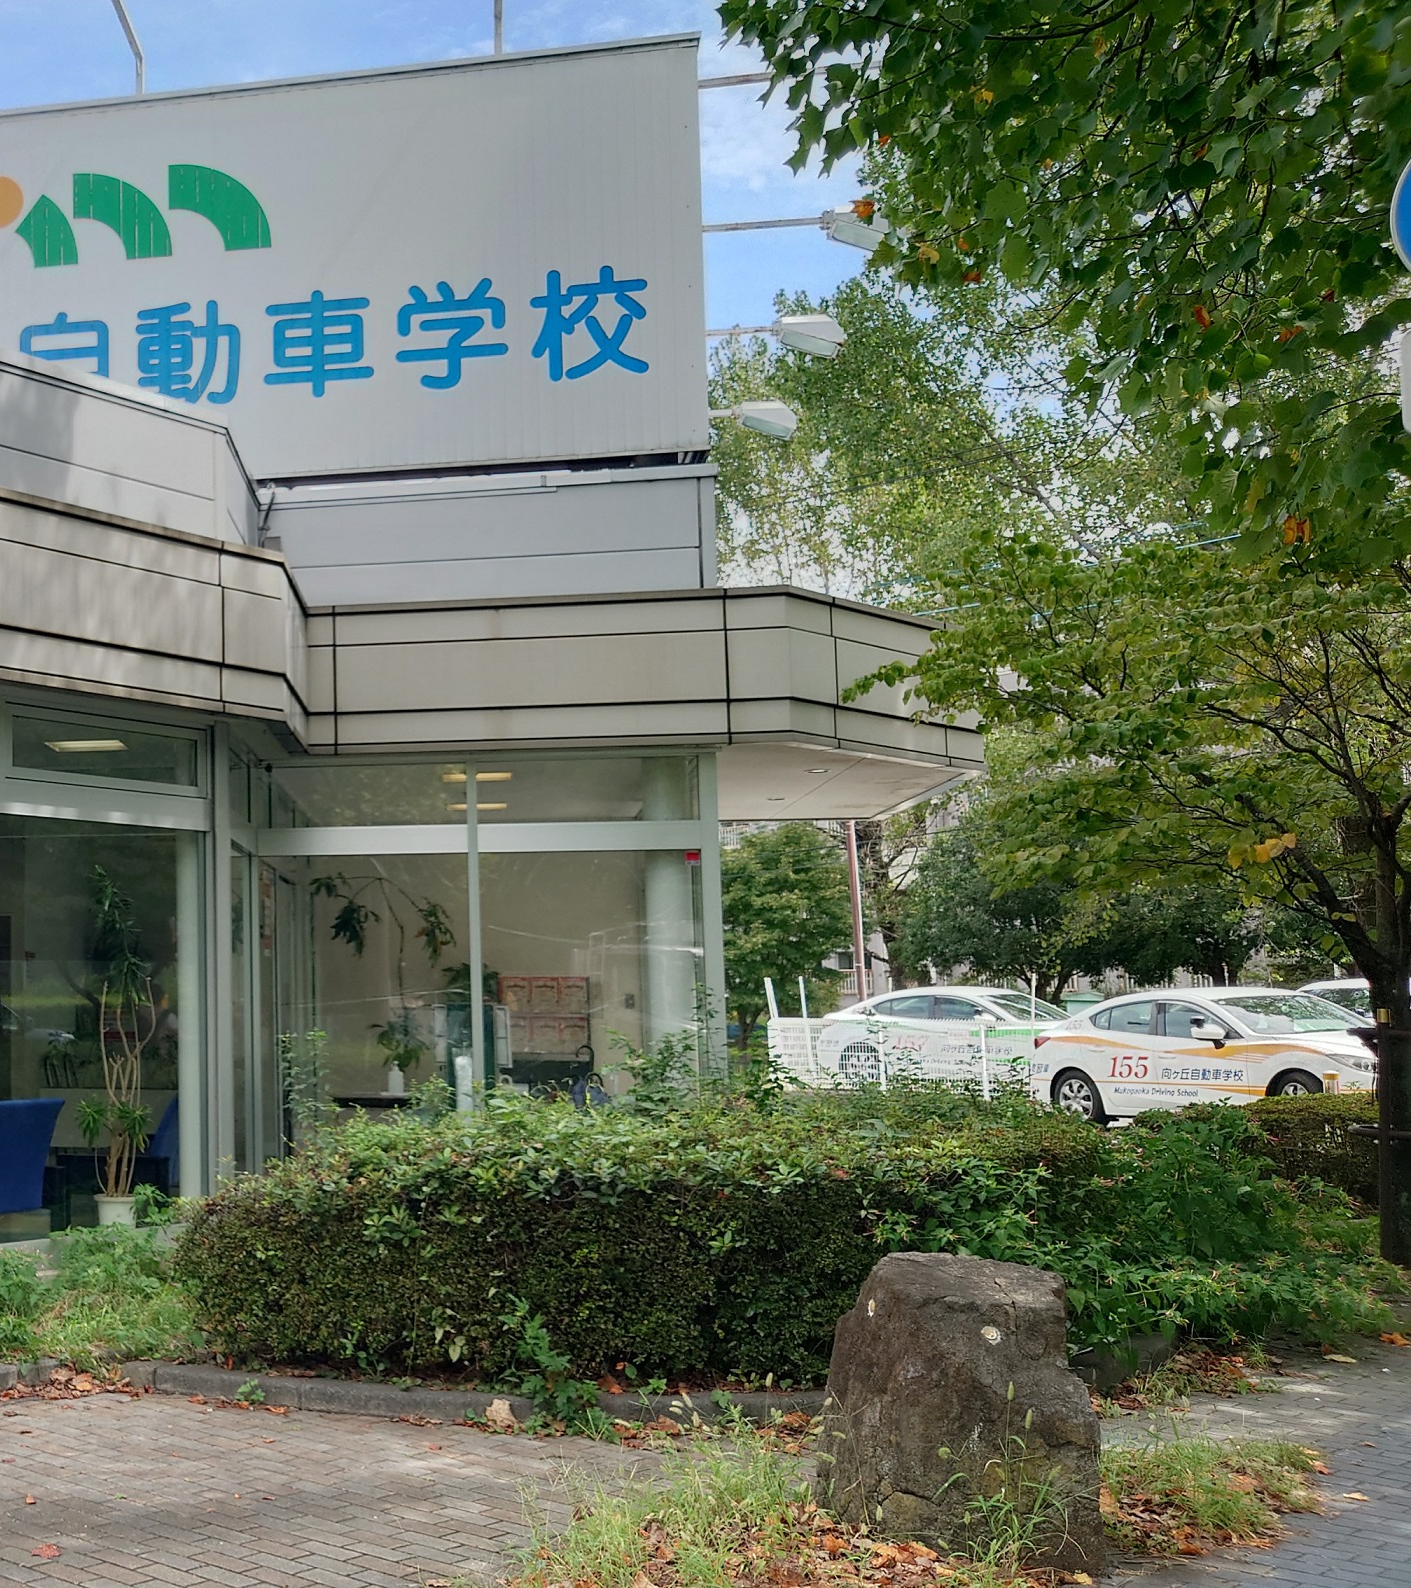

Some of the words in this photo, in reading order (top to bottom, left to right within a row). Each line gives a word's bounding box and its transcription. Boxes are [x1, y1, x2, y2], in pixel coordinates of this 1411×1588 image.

[1107, 1056, 1149, 1079] 155
[1161, 1067, 1244, 1082] 向ヶ丘自動車学校
[1151, 1087, 1175, 1097] Driving
[1177, 1088, 1199, 1098] School
